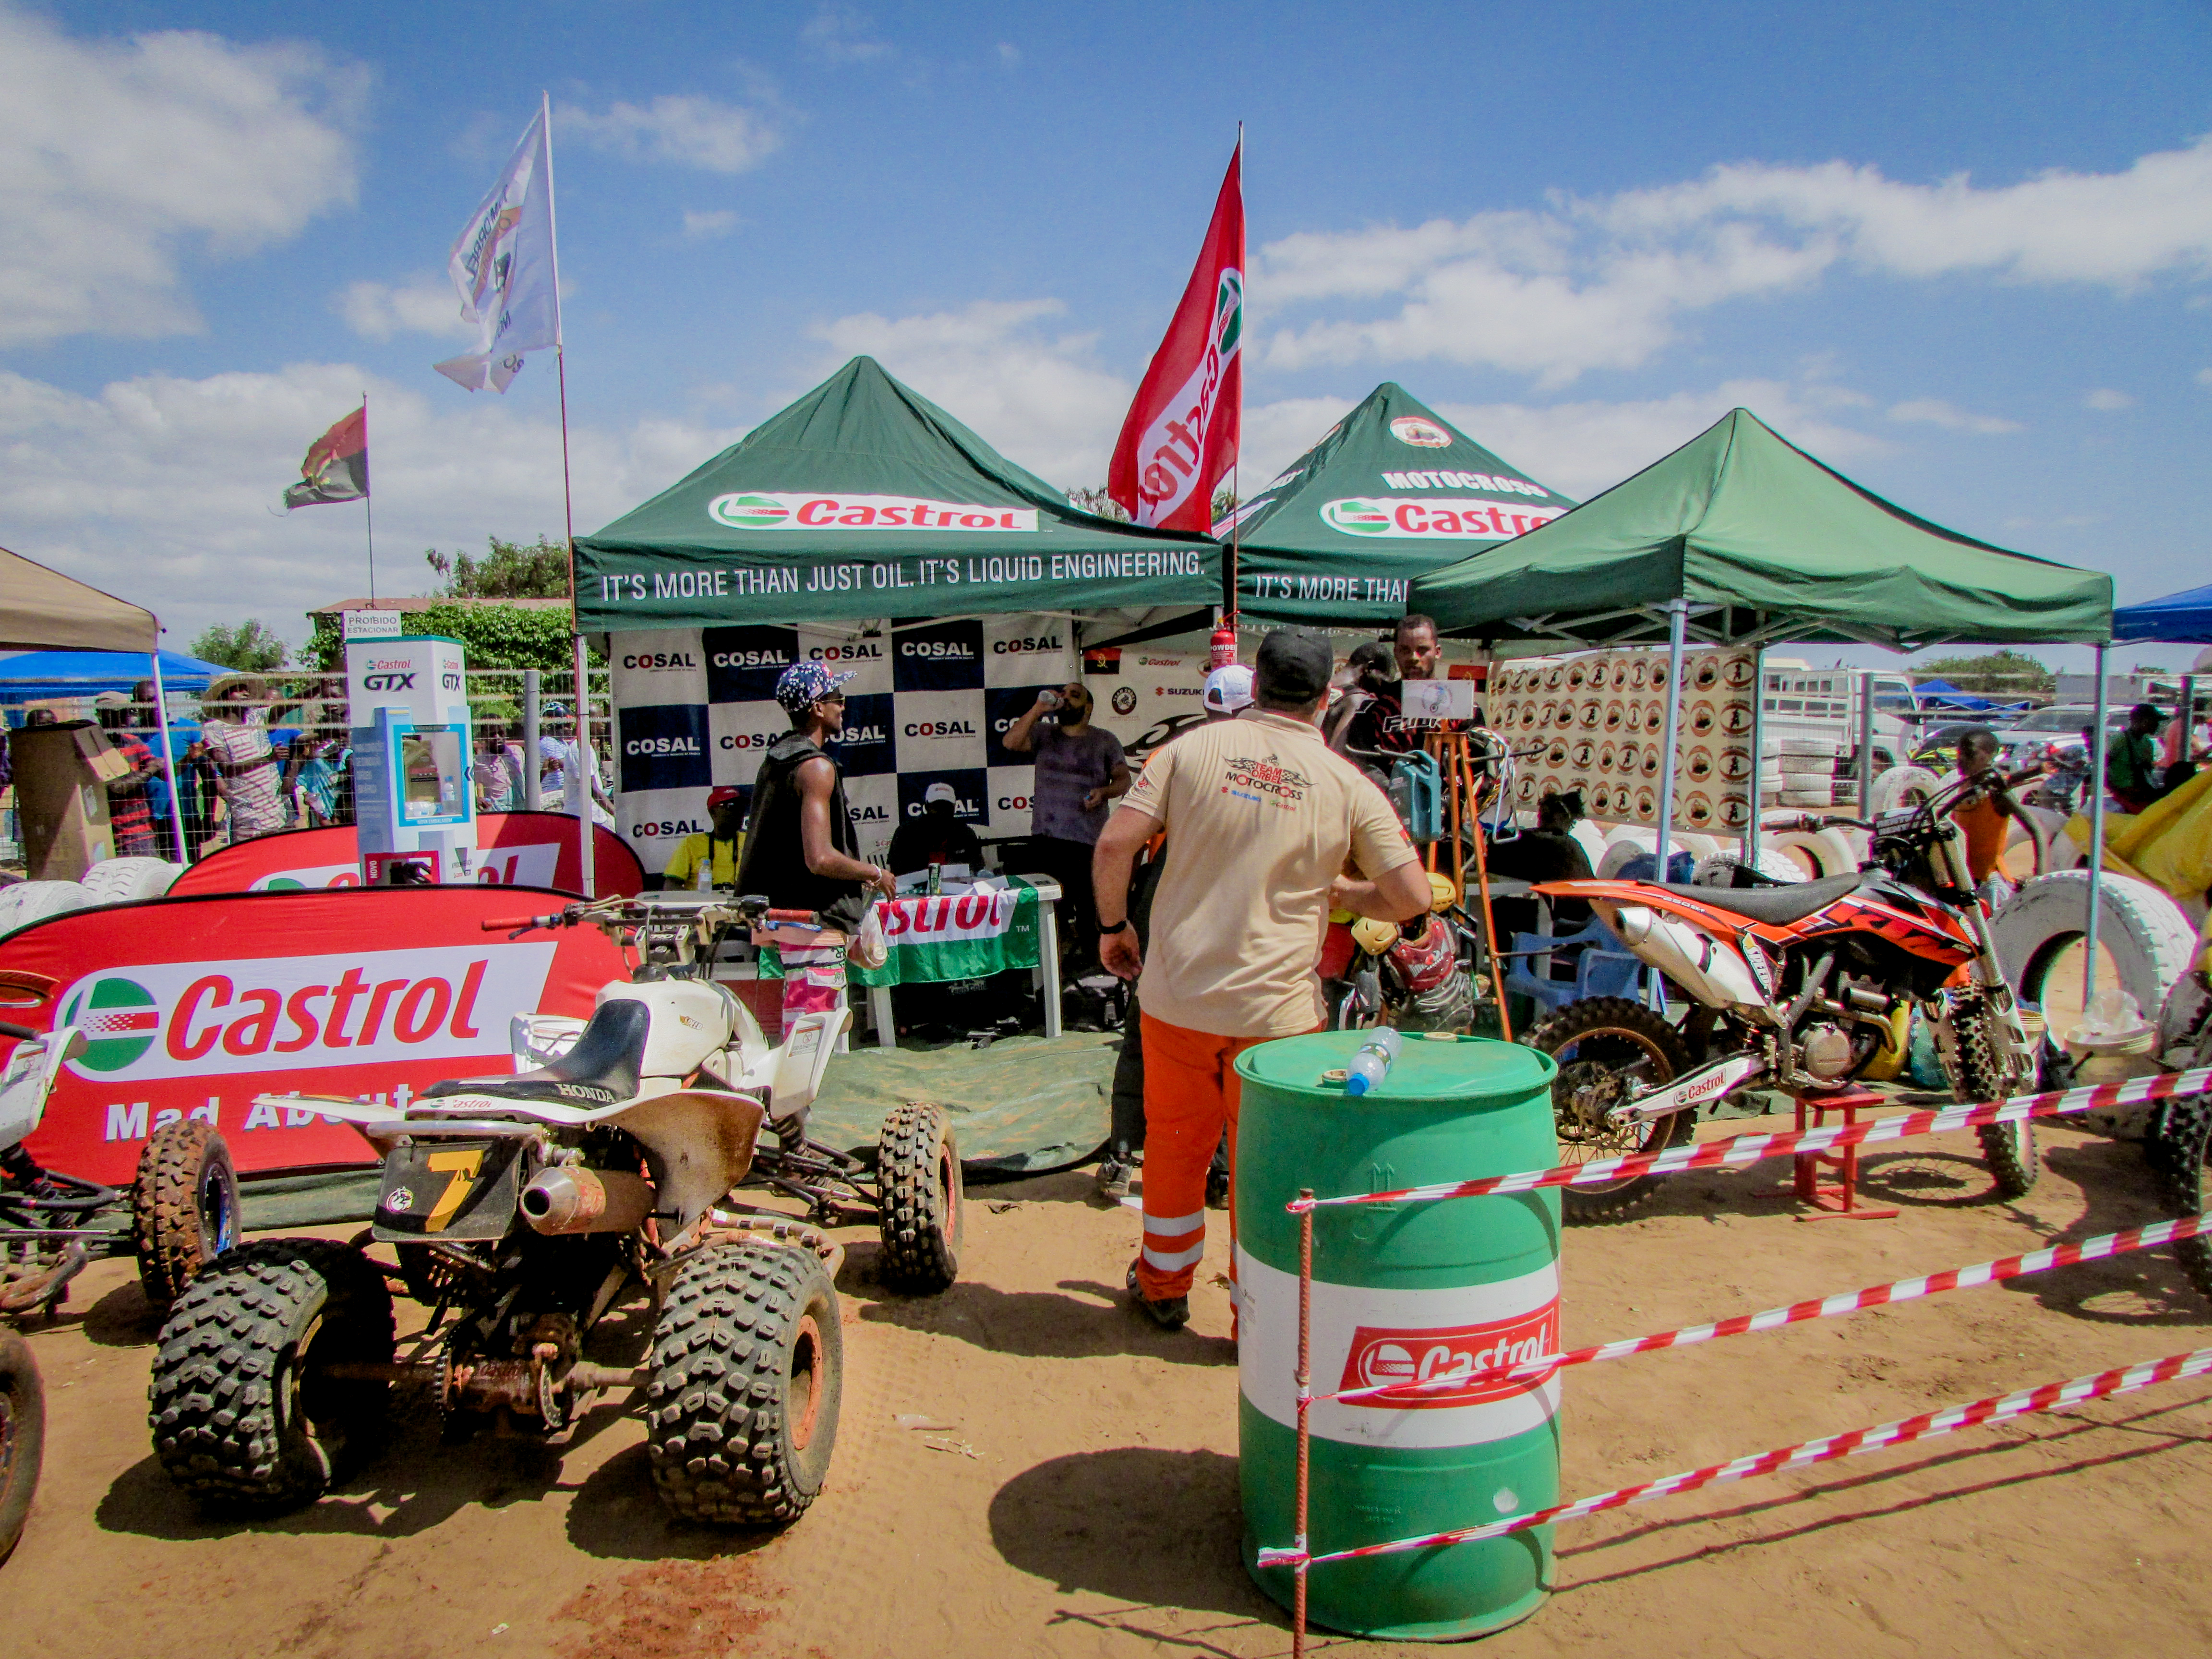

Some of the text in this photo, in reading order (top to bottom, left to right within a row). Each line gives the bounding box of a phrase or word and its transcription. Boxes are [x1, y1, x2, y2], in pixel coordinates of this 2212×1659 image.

[1382, 470, 1549, 498] MOTOCROSS
[797, 500, 1022, 529] Castrol
[1395, 504, 1552, 535] Castro
[603, 551, 1205, 601] IT'S MORE THAN JUST OIL. IT'S LIQUID ENGINEERING.
[1256, 576, 1292, 599] IT'S
[1298, 577, 1358, 601] MORE
[809, 644, 883, 660] COSAL
[901, 642, 974, 656] COSAL
[994, 636, 1063, 654] COSAL
[377, 659, 411, 670] Castrol
[624, 652, 696, 669] COSAL
[713, 650, 790, 667] COSAL
[364, 673, 419, 691] GTX
[443, 673, 461, 691] GTX
[825, 725, 886, 743] OSAL
[905, 721, 975, 737] COSAL
[626, 737, 700, 755] COSAL
[720, 733, 778, 749] COSA
[1251, 770, 1283, 784] ORBEL
[1255, 761, 1283, 776] TEAM
[1225, 771, 1303, 800] MOTOCROSS
[849, 805, 890, 820] SAL
[1276, 802, 1296, 811] Castrol
[633, 820, 704, 838] COSAL
[167, 959, 489, 1061] Castrol
[556, 1083, 616, 1103] HONDA
[1688, 1071, 1725, 1099] Castrol
[428, 1150, 483, 1232] 7
